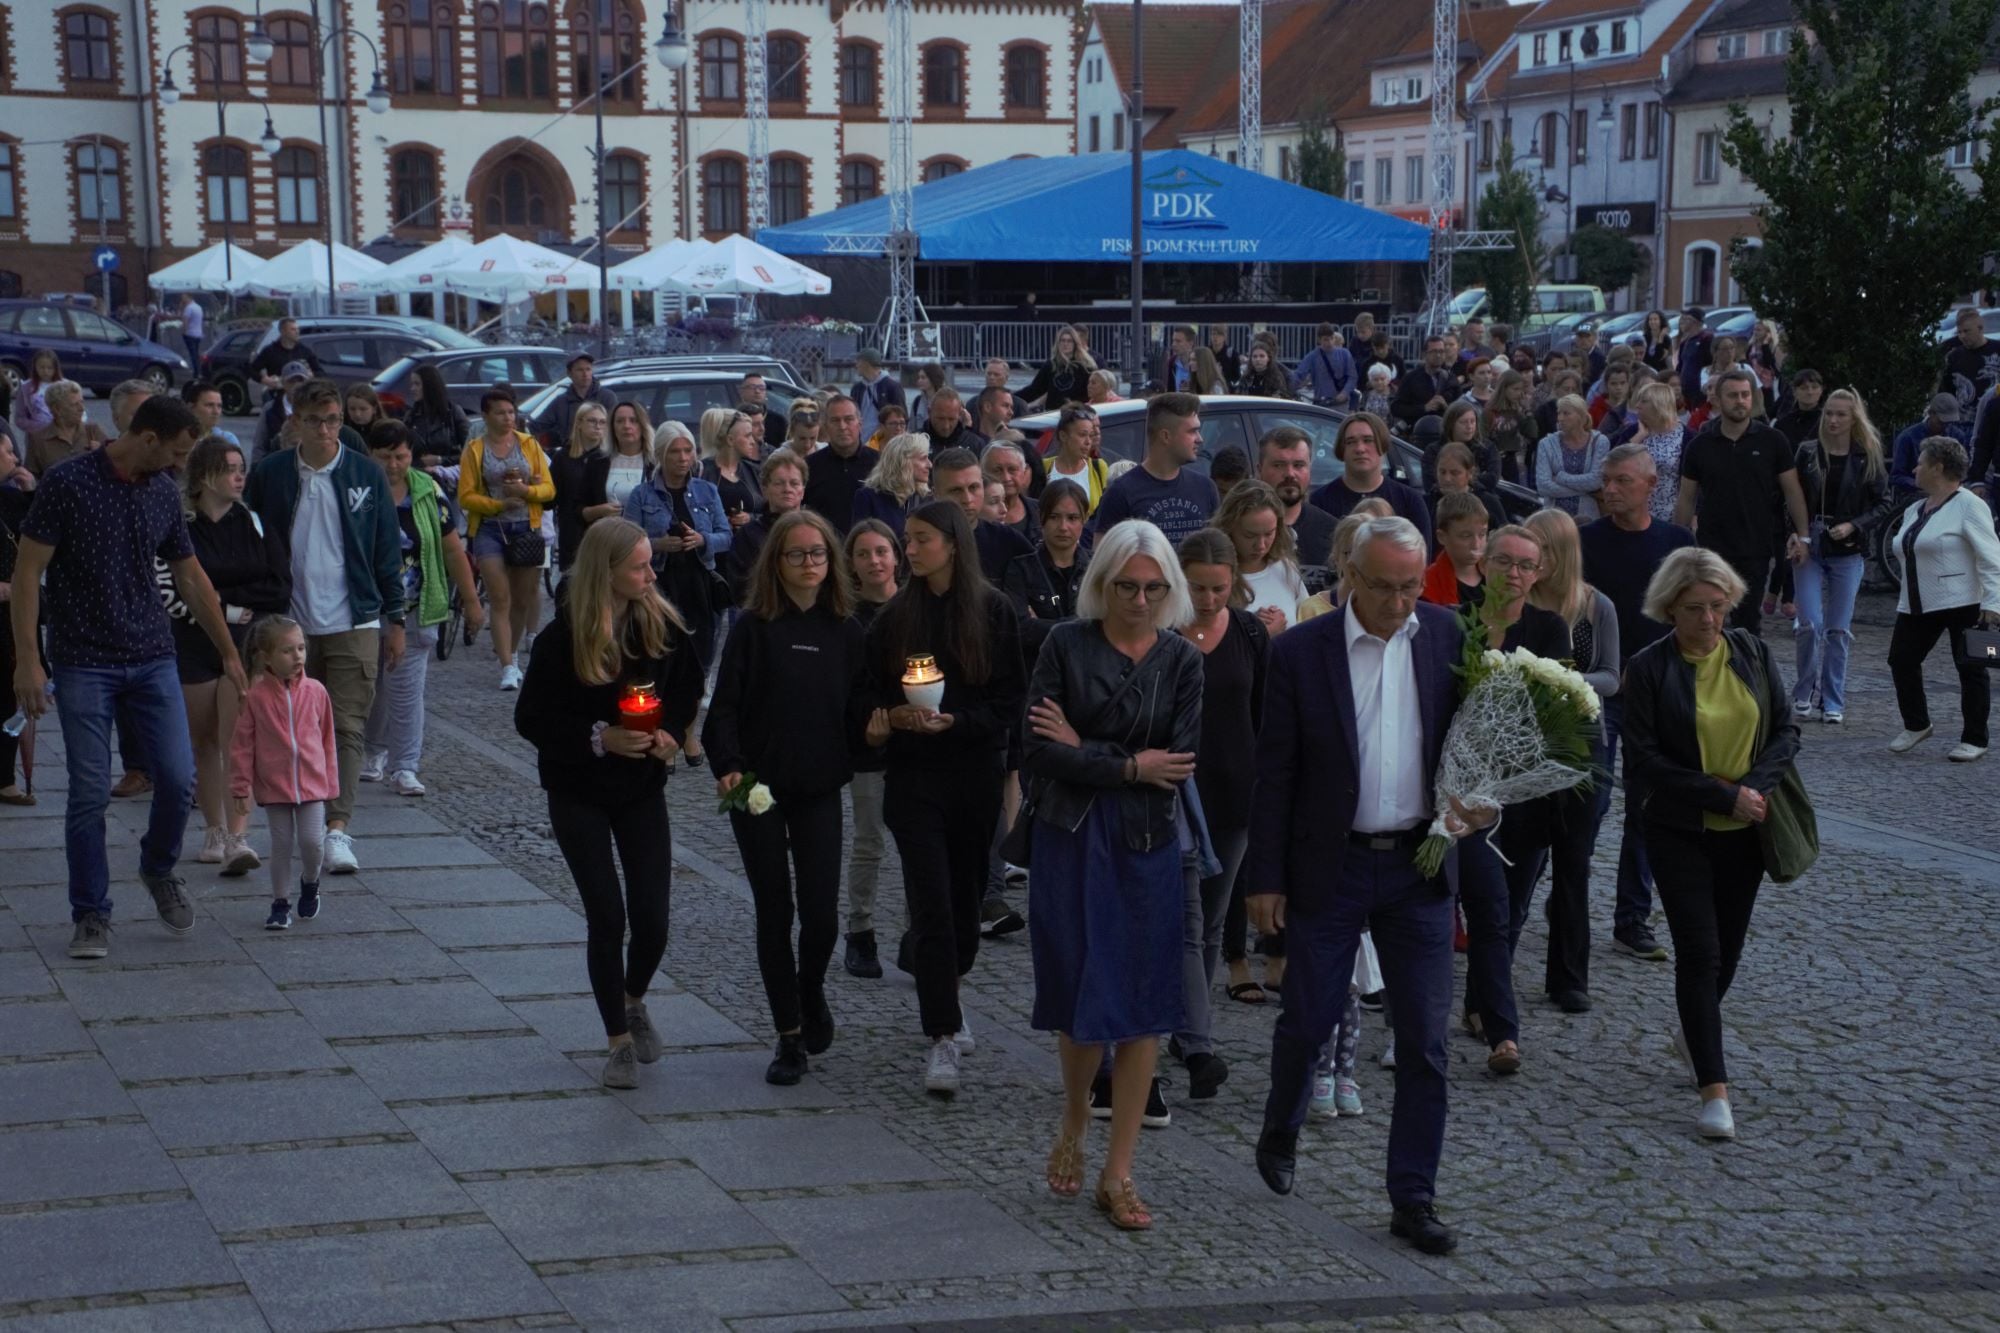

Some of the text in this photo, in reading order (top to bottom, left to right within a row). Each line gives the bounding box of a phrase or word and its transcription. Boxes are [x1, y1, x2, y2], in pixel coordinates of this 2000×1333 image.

[1152, 193, 1216, 218] PDK
[1146, 239, 1183, 252] DOM
[1187, 239, 1260, 253] KULTURY
[1158, 519, 1204, 530] TABLISHED
